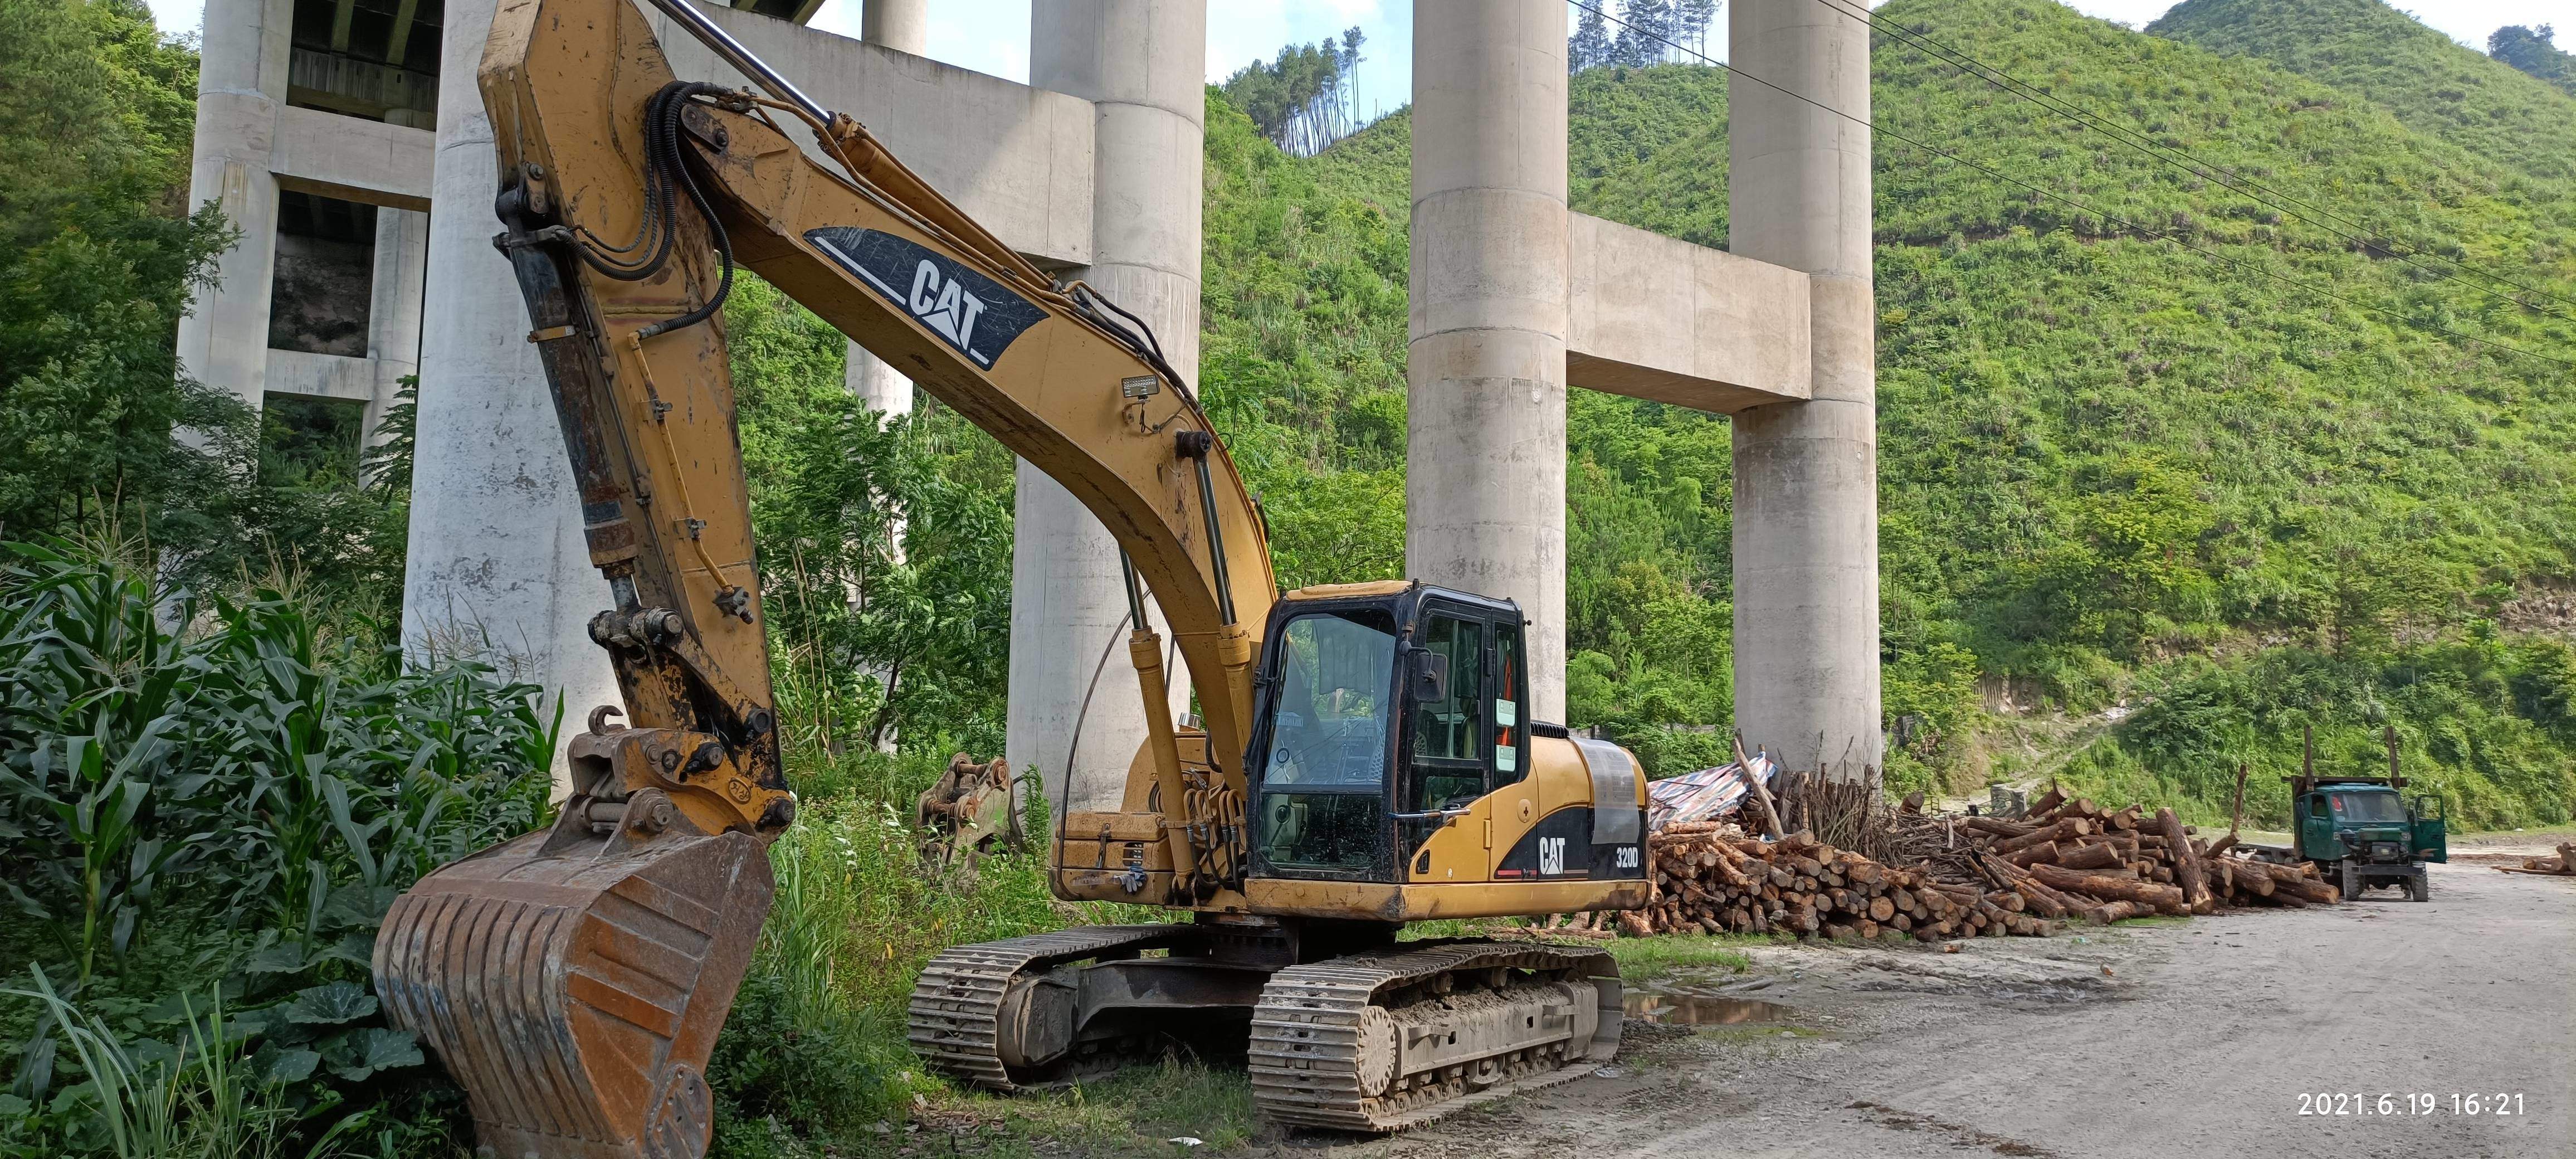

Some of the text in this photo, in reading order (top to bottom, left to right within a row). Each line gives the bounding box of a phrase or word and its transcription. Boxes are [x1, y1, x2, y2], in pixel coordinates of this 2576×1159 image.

[910, 259, 984, 350] CAT
[1539, 836, 1565, 875] CAT
[1616, 846, 1638, 868] 320D
